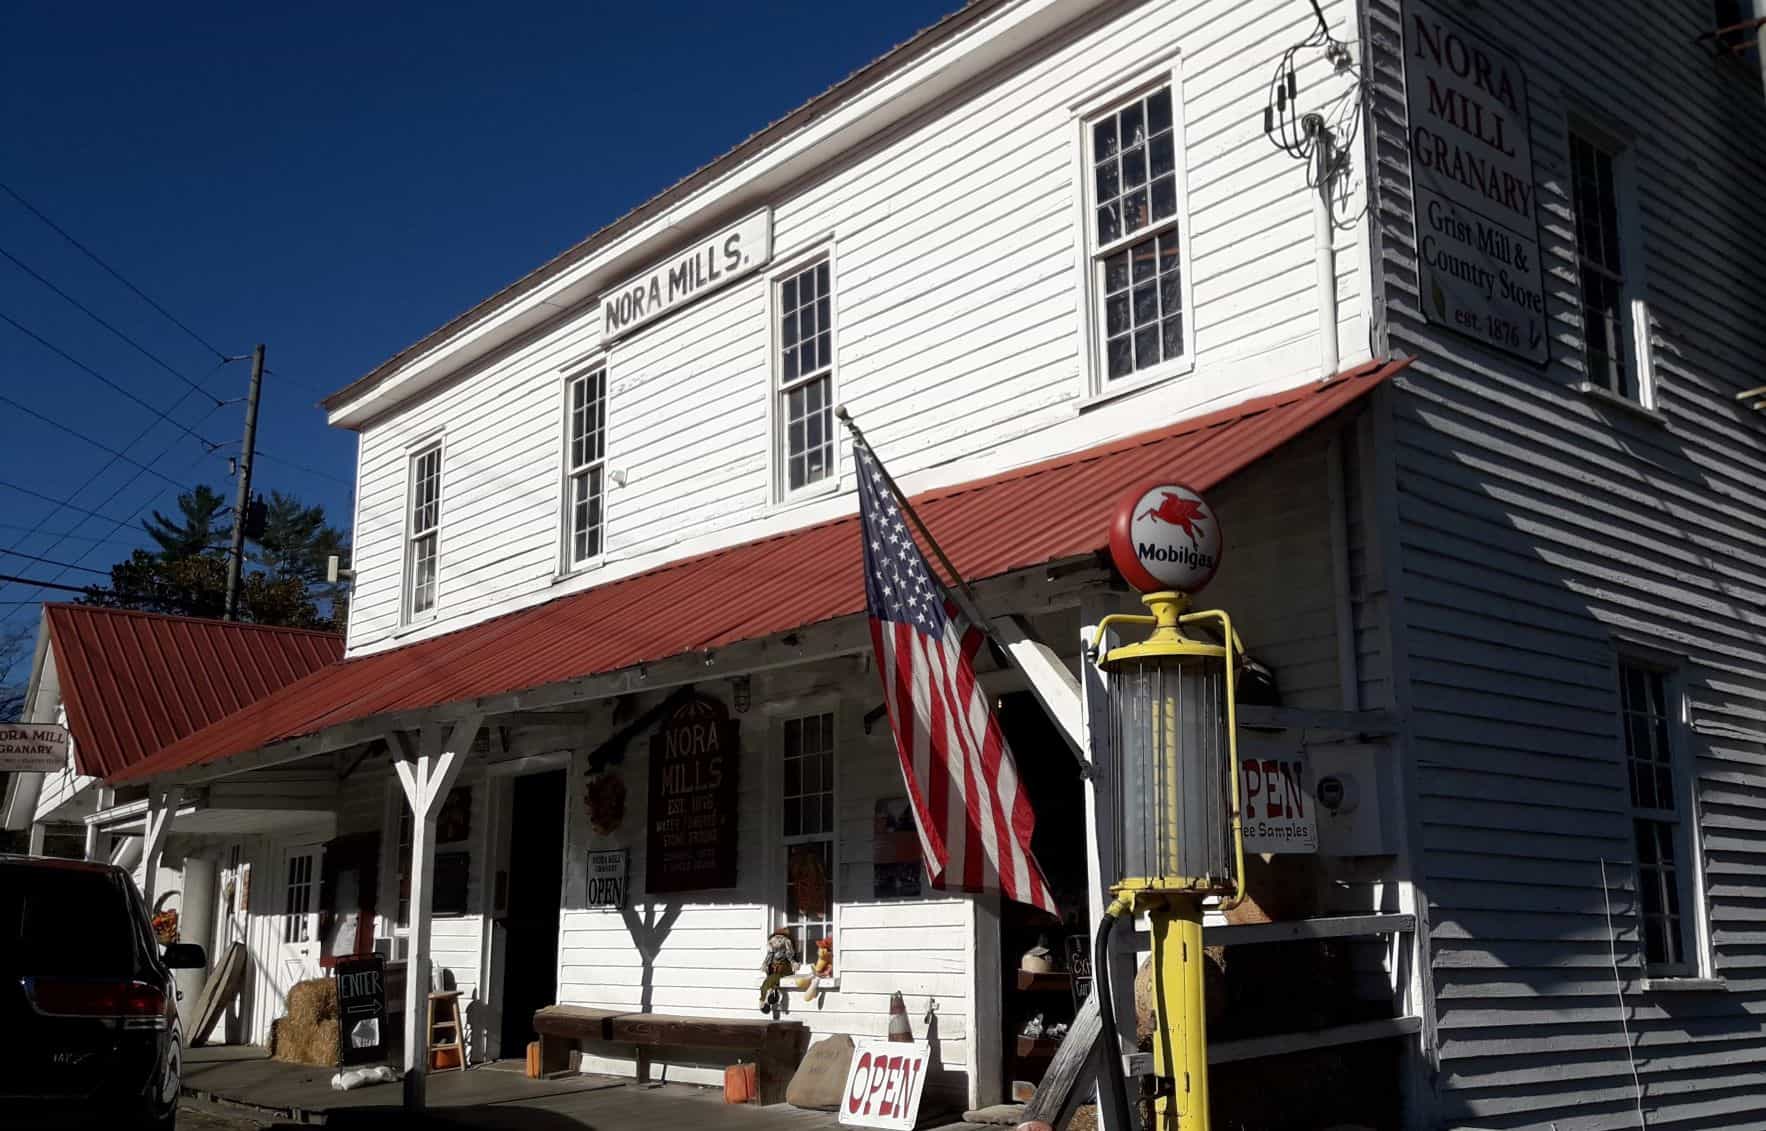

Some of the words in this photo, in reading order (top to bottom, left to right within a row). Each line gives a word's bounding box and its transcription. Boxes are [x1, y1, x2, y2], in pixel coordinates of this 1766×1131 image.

[1414, 14, 1517, 112] NORA
[1426, 75, 1515, 157] MILL
[1414, 126, 1533, 218] GRANARY
[1428, 200, 1472, 246] Grist
[1476, 222, 1511, 265] Mill
[1514, 243, 1529, 273] &
[605, 276, 662, 334] NORA
[669, 233, 749, 302] MILLS.
[1423, 235, 1495, 300] Country
[1500, 270, 1542, 313] Store
[1488, 314, 1520, 347] 1876
[1138, 542, 1213, 570] Mobilgas
[0, 730, 27, 741] ORA
[33, 730, 64, 744] MILL
[664, 720, 720, 760] NORA
[661, 755, 724, 797] MILLS
[1241, 759, 1304, 818] PEN
[1258, 822, 1308, 840] Samples
[588, 878, 623, 905] OPEN
[849, 1052, 922, 1119] OPEN
